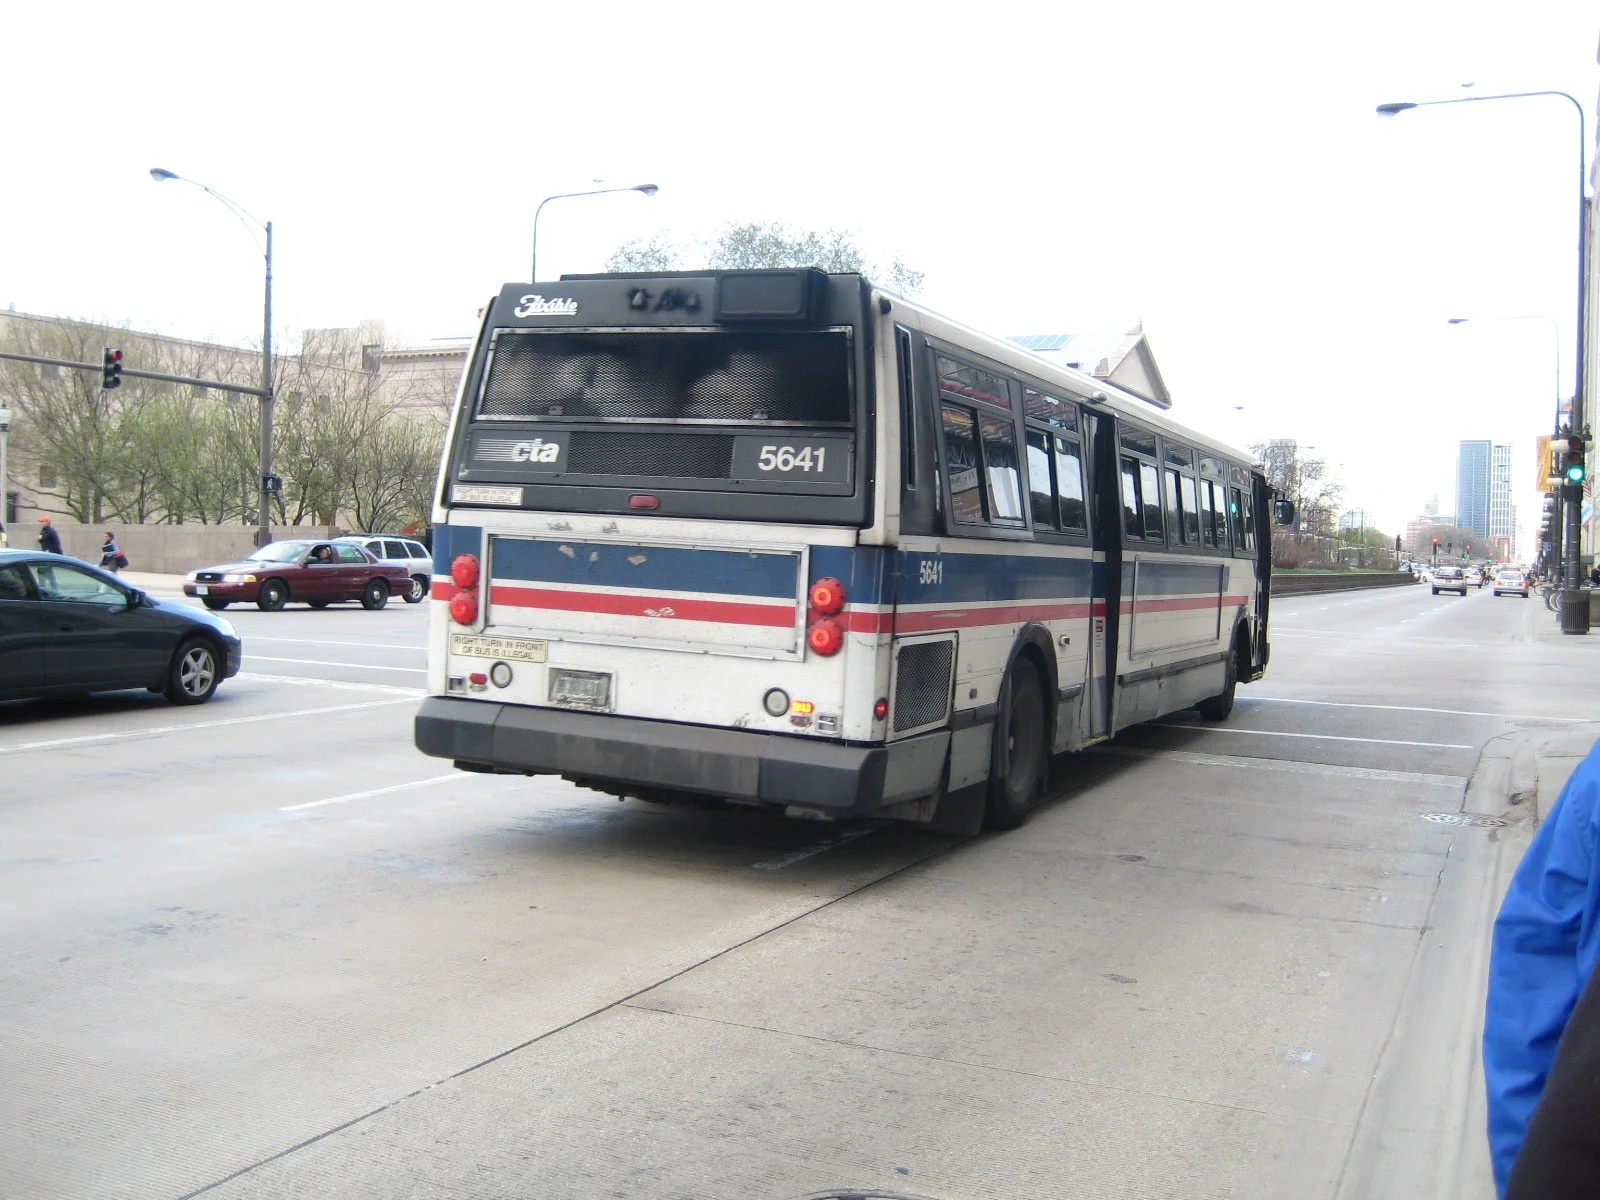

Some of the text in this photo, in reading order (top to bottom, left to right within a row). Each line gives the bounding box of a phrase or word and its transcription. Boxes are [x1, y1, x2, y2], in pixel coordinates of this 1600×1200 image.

[512, 438, 560, 463] cta
[757, 445, 826, 472] 5641
[919, 560, 943, 585] 5641
[454, 636, 544, 650] RIGHT TURN IN FRONT
[462, 645, 535, 660] OF BUS IS ILLEGAL
